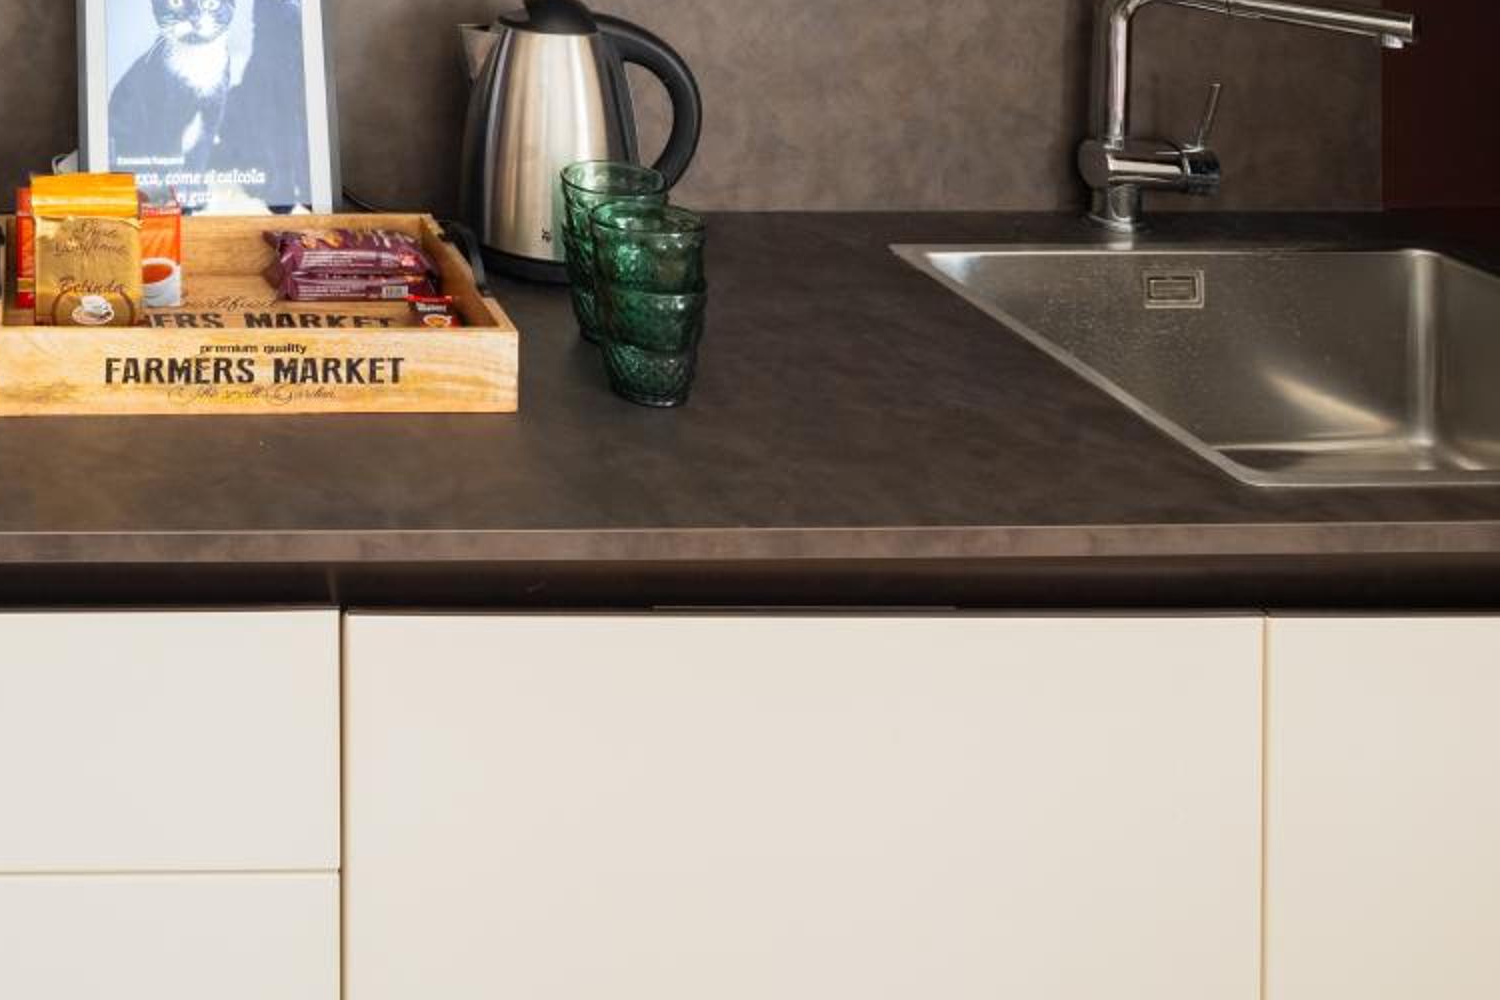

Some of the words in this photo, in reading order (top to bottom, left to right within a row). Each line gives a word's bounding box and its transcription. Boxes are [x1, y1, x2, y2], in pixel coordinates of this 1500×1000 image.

[217, 168, 266, 184] calcola
[199, 344, 259, 354] premium
[263, 343, 308, 354] quality
[104, 357, 255, 384] FARMERS
[273, 357, 405, 384] MARKET
